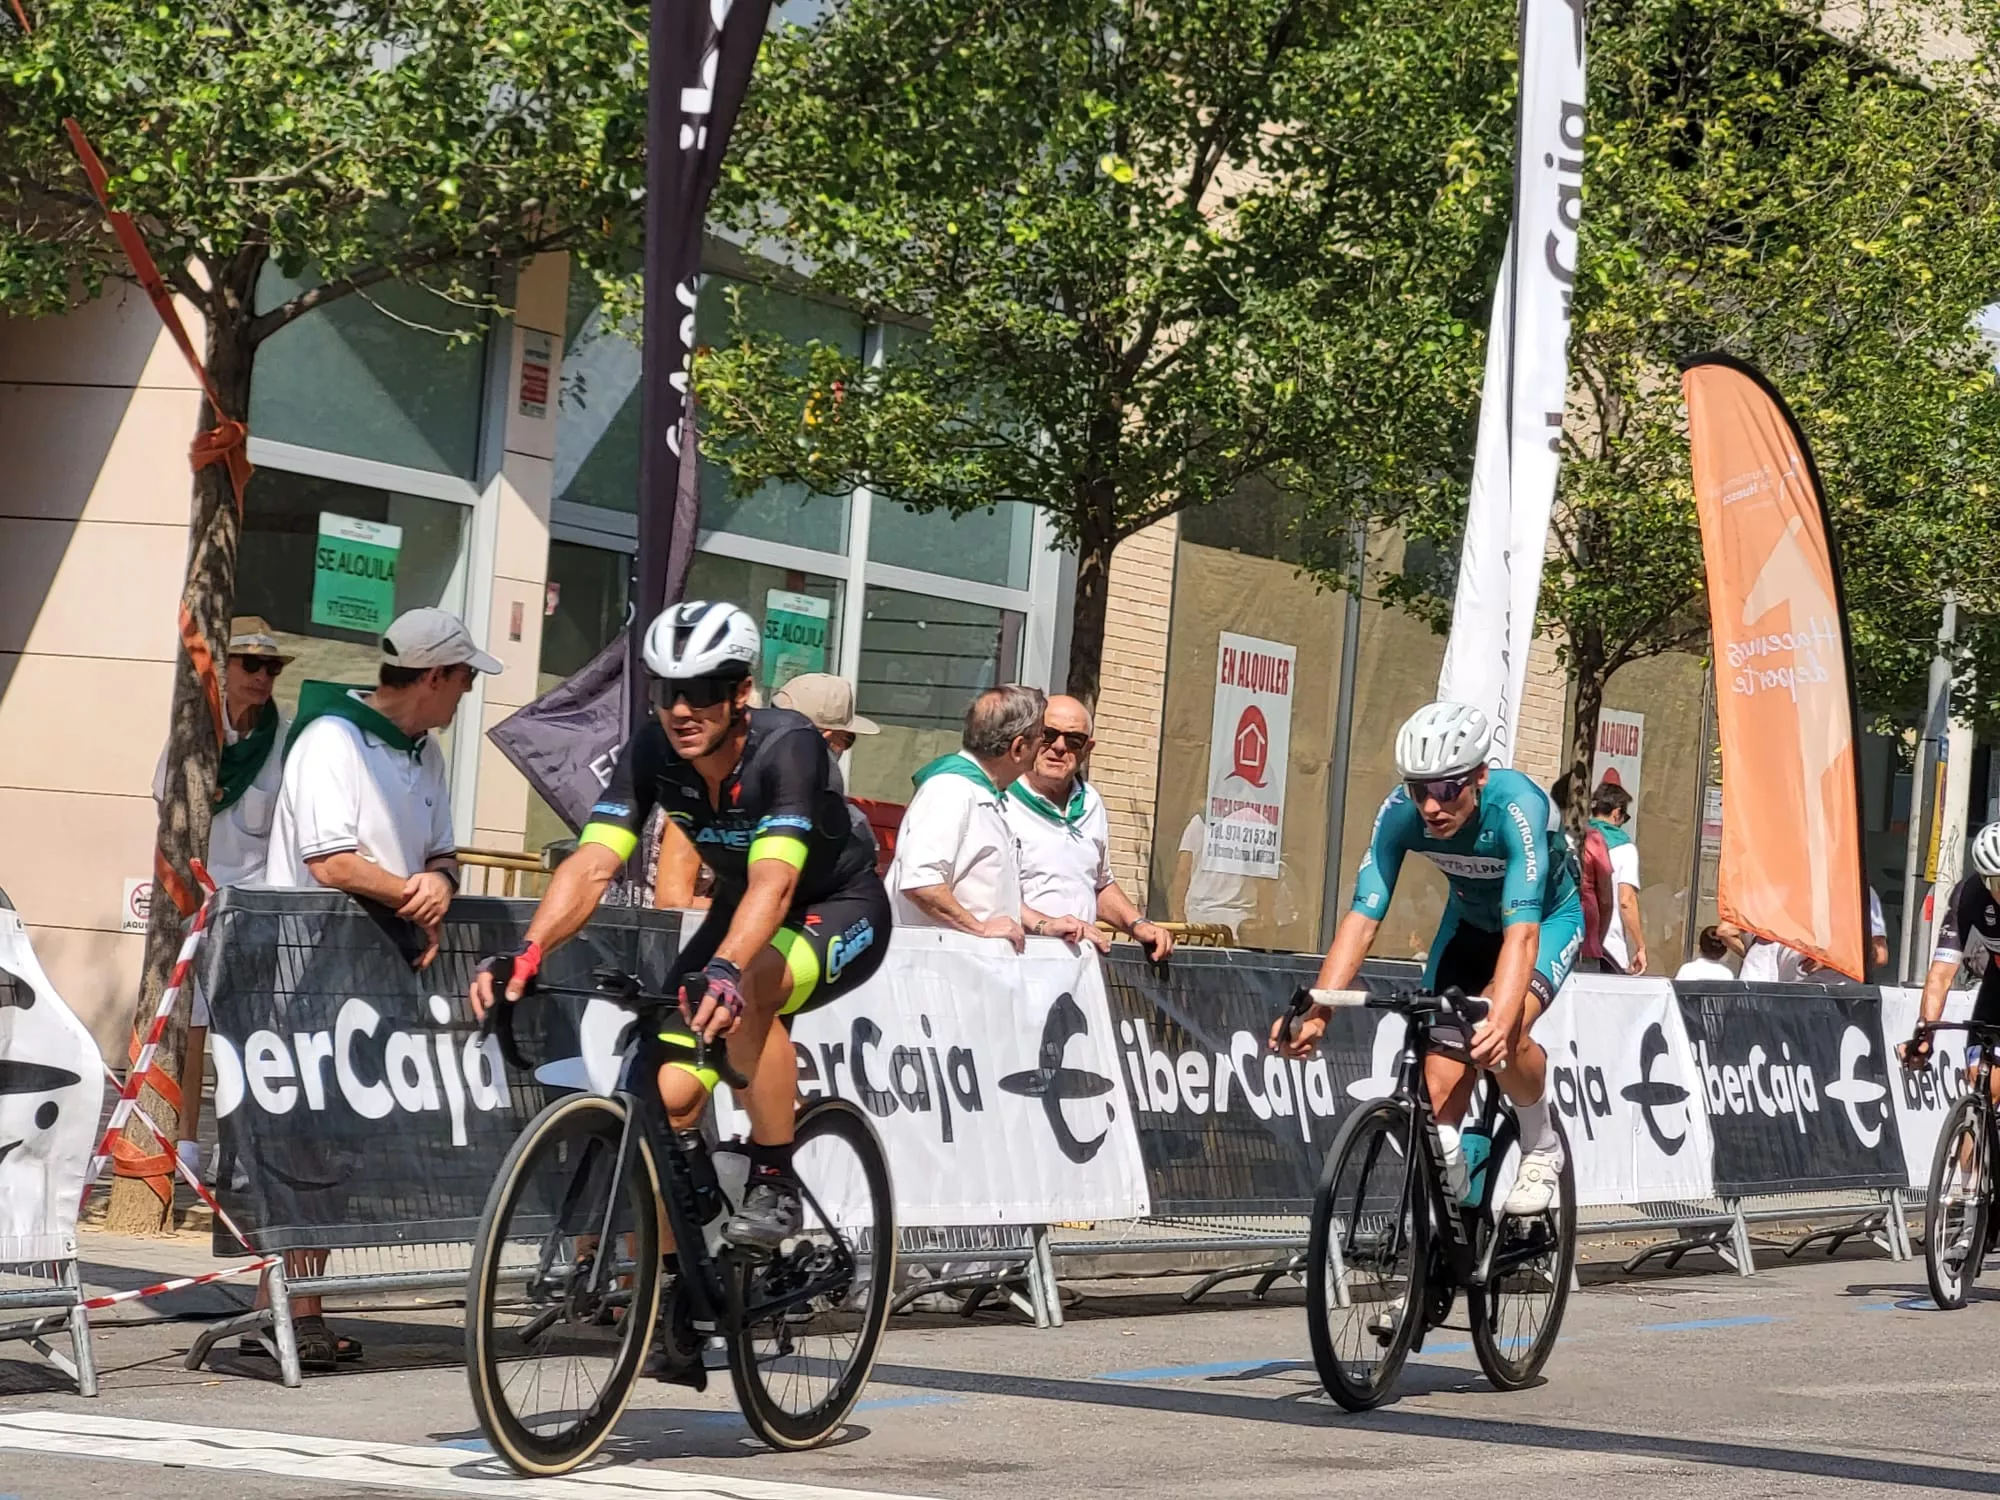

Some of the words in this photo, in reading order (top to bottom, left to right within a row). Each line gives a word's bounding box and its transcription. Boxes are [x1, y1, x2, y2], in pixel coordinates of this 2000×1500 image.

[317, 547, 336, 571] SE
[337, 551, 395, 583] ALQUILA
[765, 620, 779, 640] SE
[1221, 647, 1237, 685] EN
[1237, 650, 1290, 696] ALQUILER
[1600, 720, 1640, 757] ALQUILER
[1506, 802, 1537, 882] CONTROLPACK
